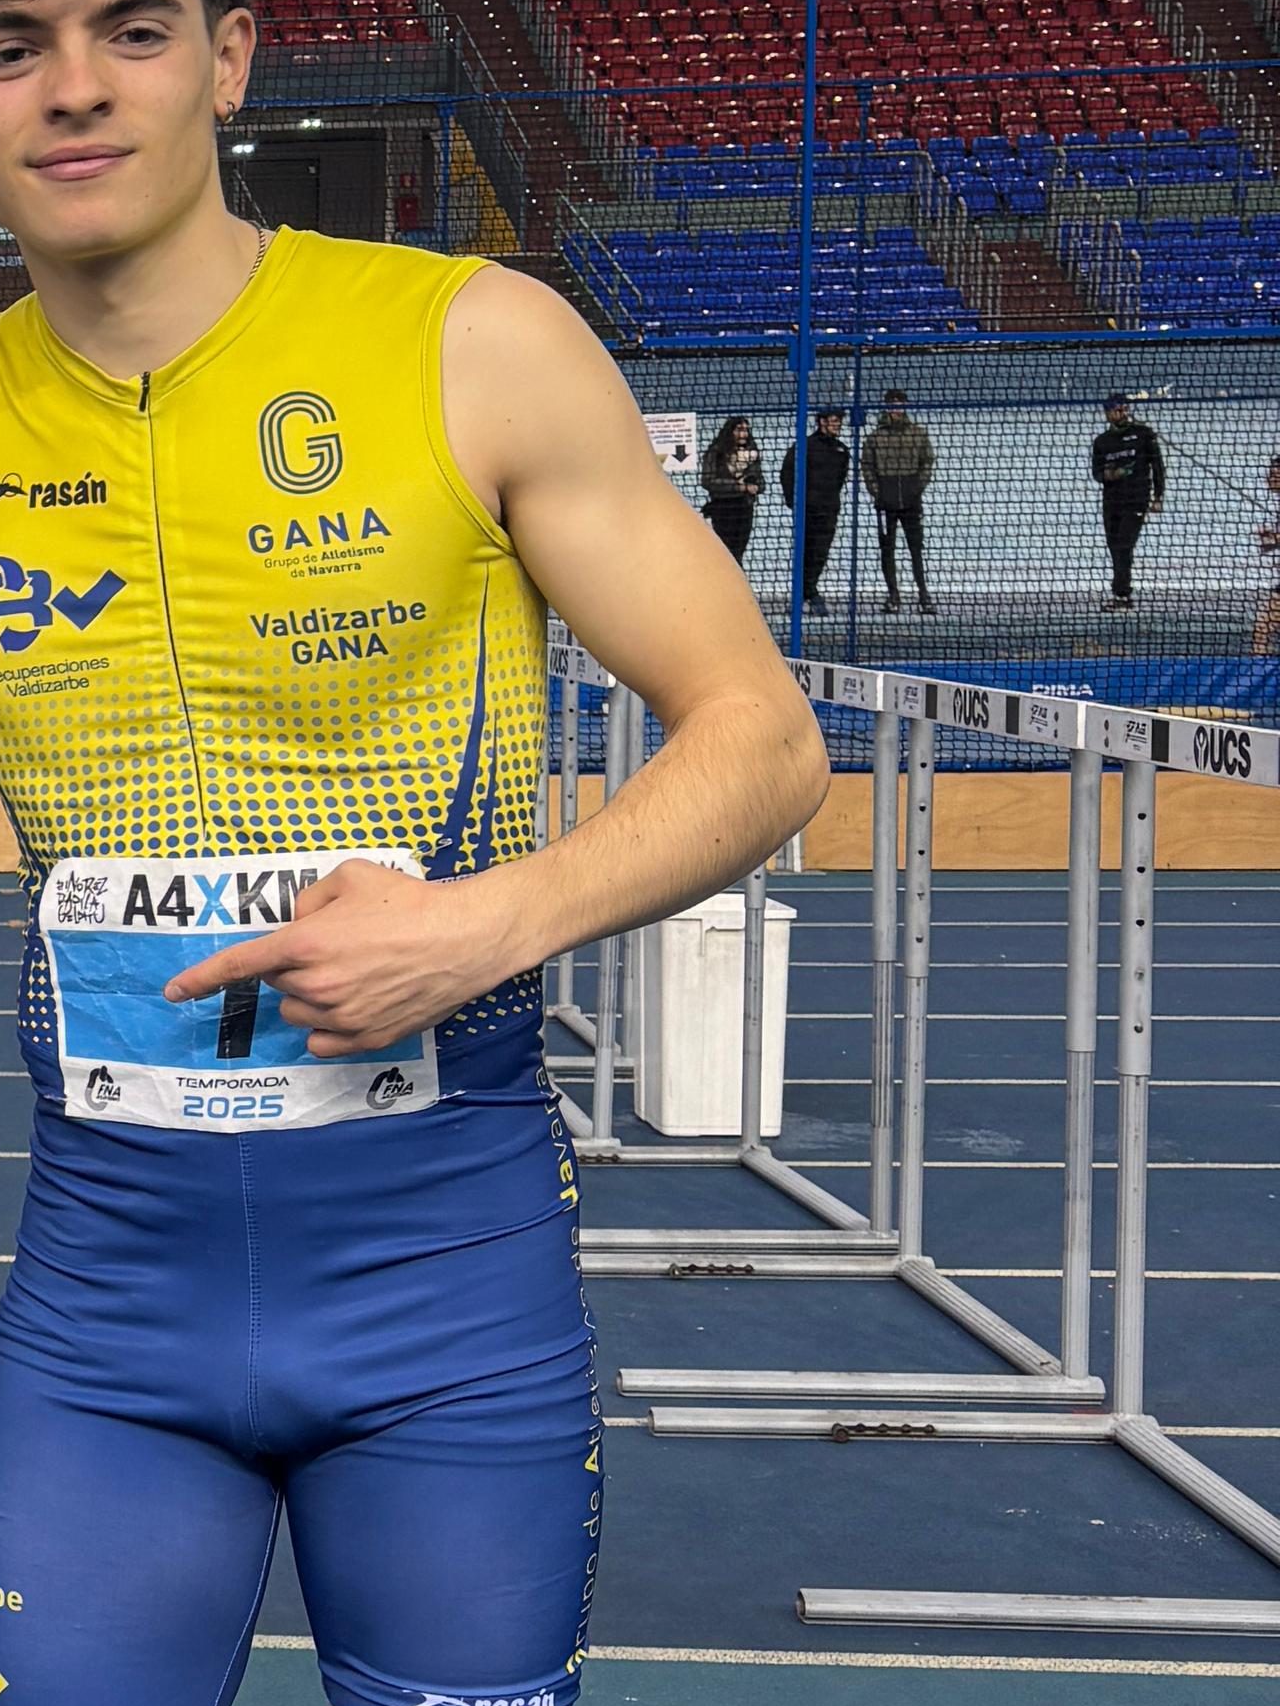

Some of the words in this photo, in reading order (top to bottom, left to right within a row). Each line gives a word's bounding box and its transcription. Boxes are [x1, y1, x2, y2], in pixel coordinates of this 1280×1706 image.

[28, 471, 107, 509] rasán
[248, 507, 392, 554] GANA
[264, 556, 300, 570] Grupo
[303, 553, 318, 564] de
[290, 566, 306, 578] de
[308, 561, 362, 577] Navarra
[250, 599, 427, 639] Valdizarbe
[291, 632, 389, 665] GANA
[7, 675, 90, 698] Valdizarbe
[963, 688, 989, 729] UCS
[1209, 727, 1252, 778] UCS
[176, 1076, 290, 1090] TEMPORADA
[183, 1094, 285, 1120] 2025
